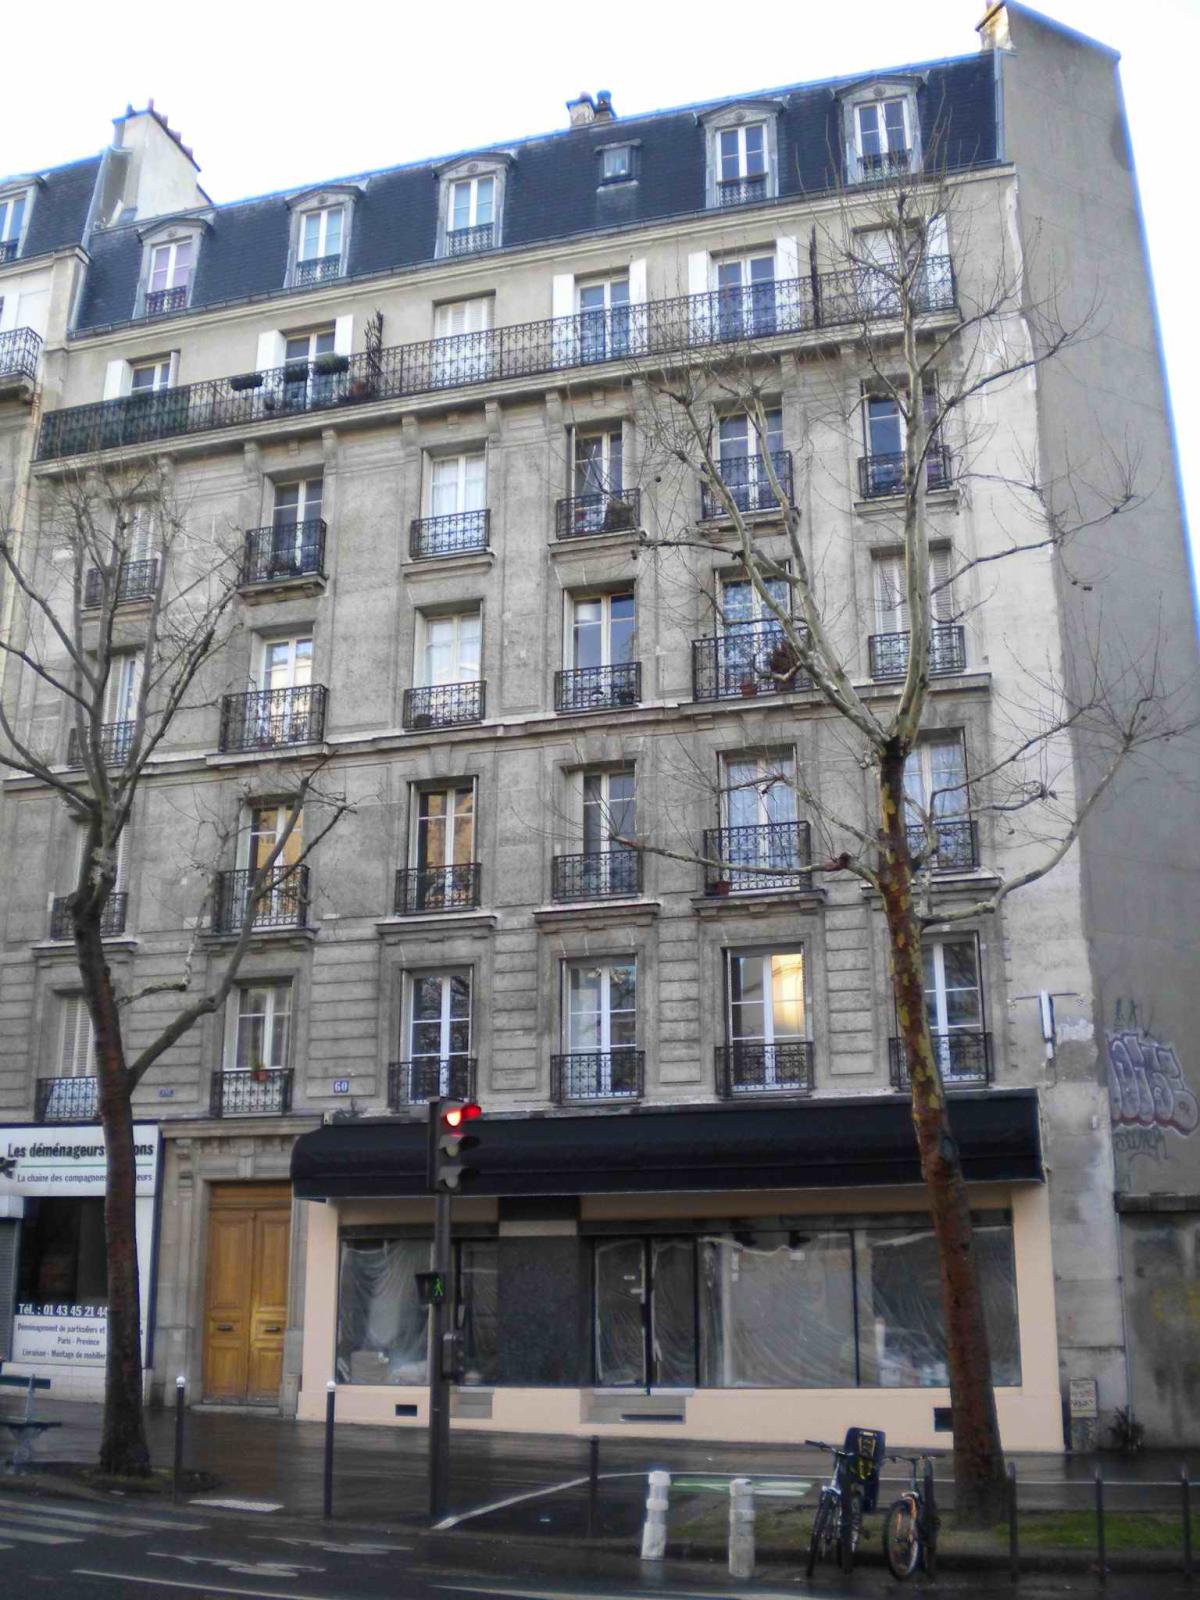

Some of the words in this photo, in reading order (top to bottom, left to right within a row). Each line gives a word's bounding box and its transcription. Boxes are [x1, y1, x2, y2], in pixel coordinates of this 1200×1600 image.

[335, 1081, 348, 1092] 60
[8, 1143, 26, 1158] Les
[29, 1143, 105, 1159] déménageurs
[17, 1174, 26, 1183] La
[50, 1173, 63, 1182] des
[64, 1175, 106, 1183] compagnons
[43, 1305, 53, 1316] 01
[56, 1305, 68, 1316] 43
[70, 1306, 82, 1317] 45
[84, 1306, 95, 1317] 21
[97, 1306, 108, 1318] 44
